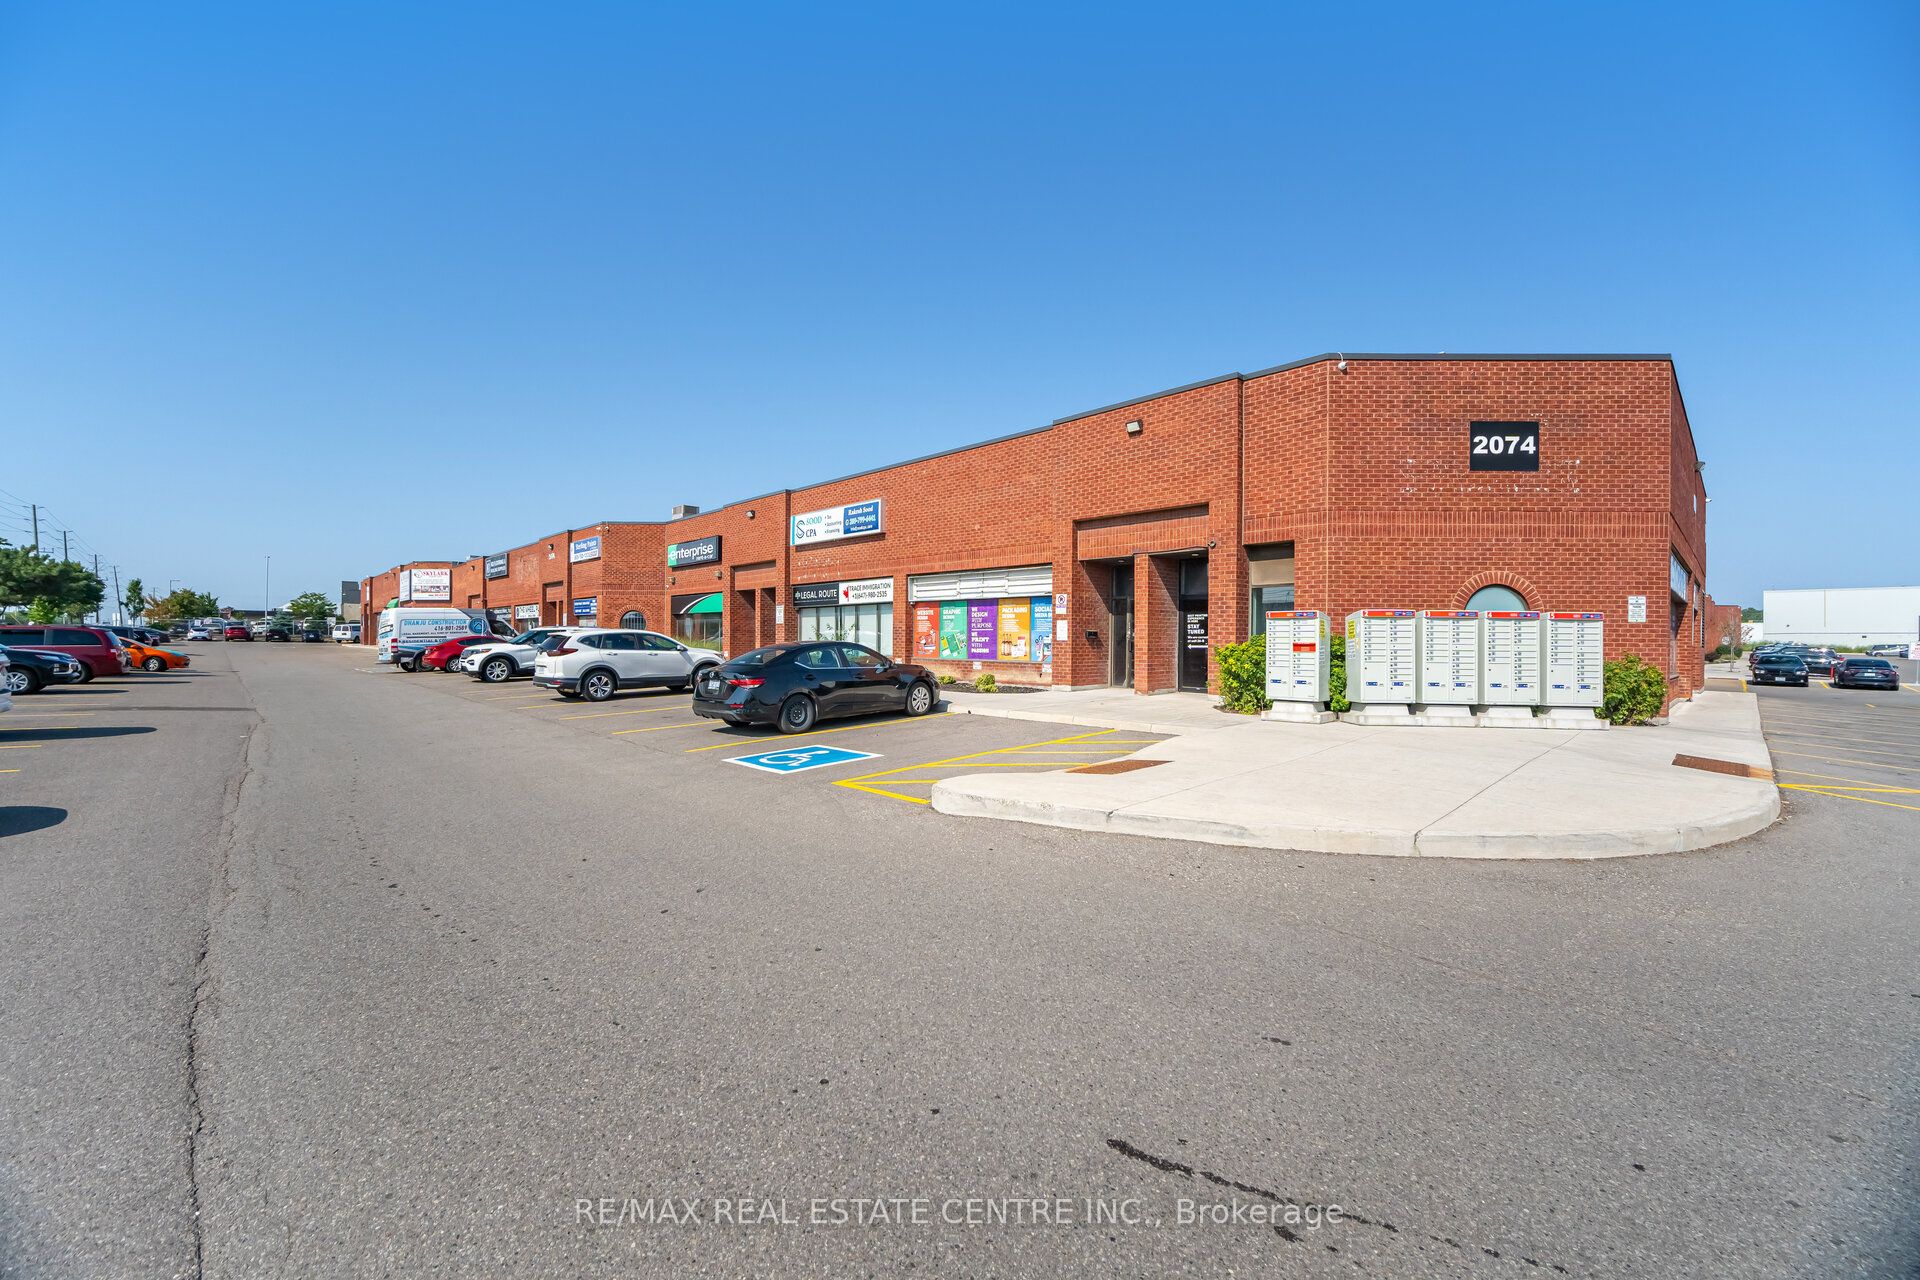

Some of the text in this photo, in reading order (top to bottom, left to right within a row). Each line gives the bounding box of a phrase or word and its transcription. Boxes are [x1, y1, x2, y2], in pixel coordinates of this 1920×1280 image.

[1473, 436, 1536, 454] 2074
[806, 516, 823, 526] SOOD
[806, 529, 817, 538] CPA
[669, 543, 714, 560] enterprise
[849, 582, 892, 592] TRACE IMMIGRATION
[800, 589, 838, 599] LEGAL ROUTE
